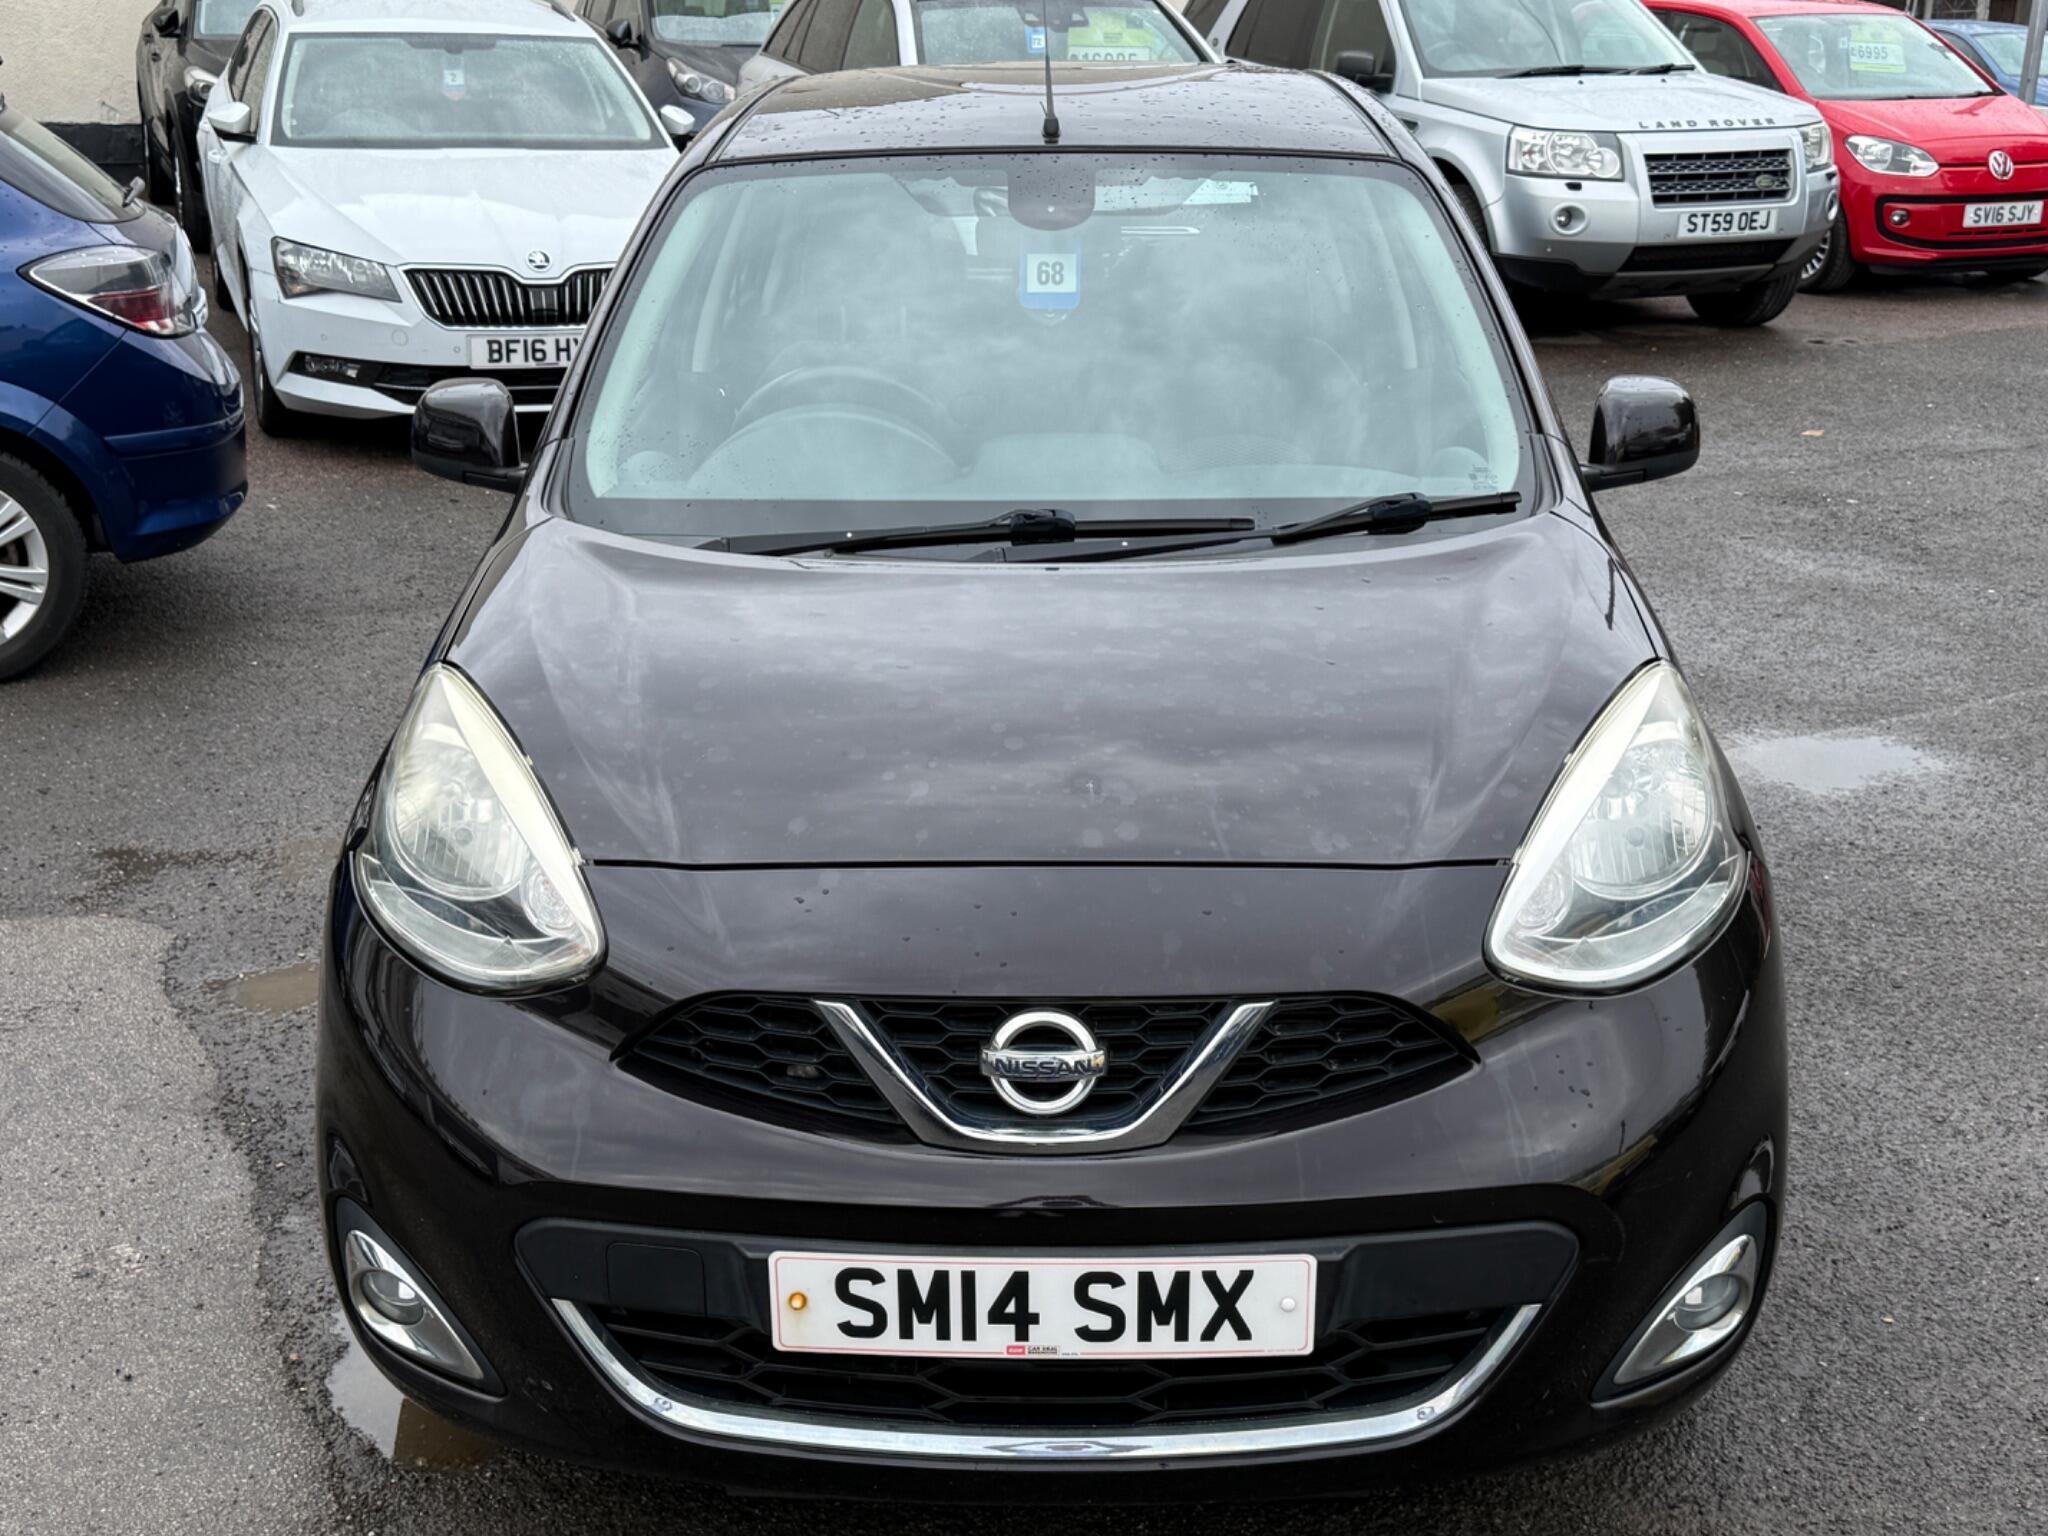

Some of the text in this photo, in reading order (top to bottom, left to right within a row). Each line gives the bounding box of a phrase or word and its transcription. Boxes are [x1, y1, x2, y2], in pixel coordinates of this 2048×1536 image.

[1638, 118, 1776, 129] LAND ROVER
[1687, 210, 1771, 233] ST59 OEJ
[1972, 204, 2035, 224] SV16 SJY
[1036, 261, 1065, 287] 68
[486, 338, 579, 363] BF16 H
[994, 1057, 1093, 1076] NISSAN
[834, 1266, 1254, 1343] SM14 SMX
